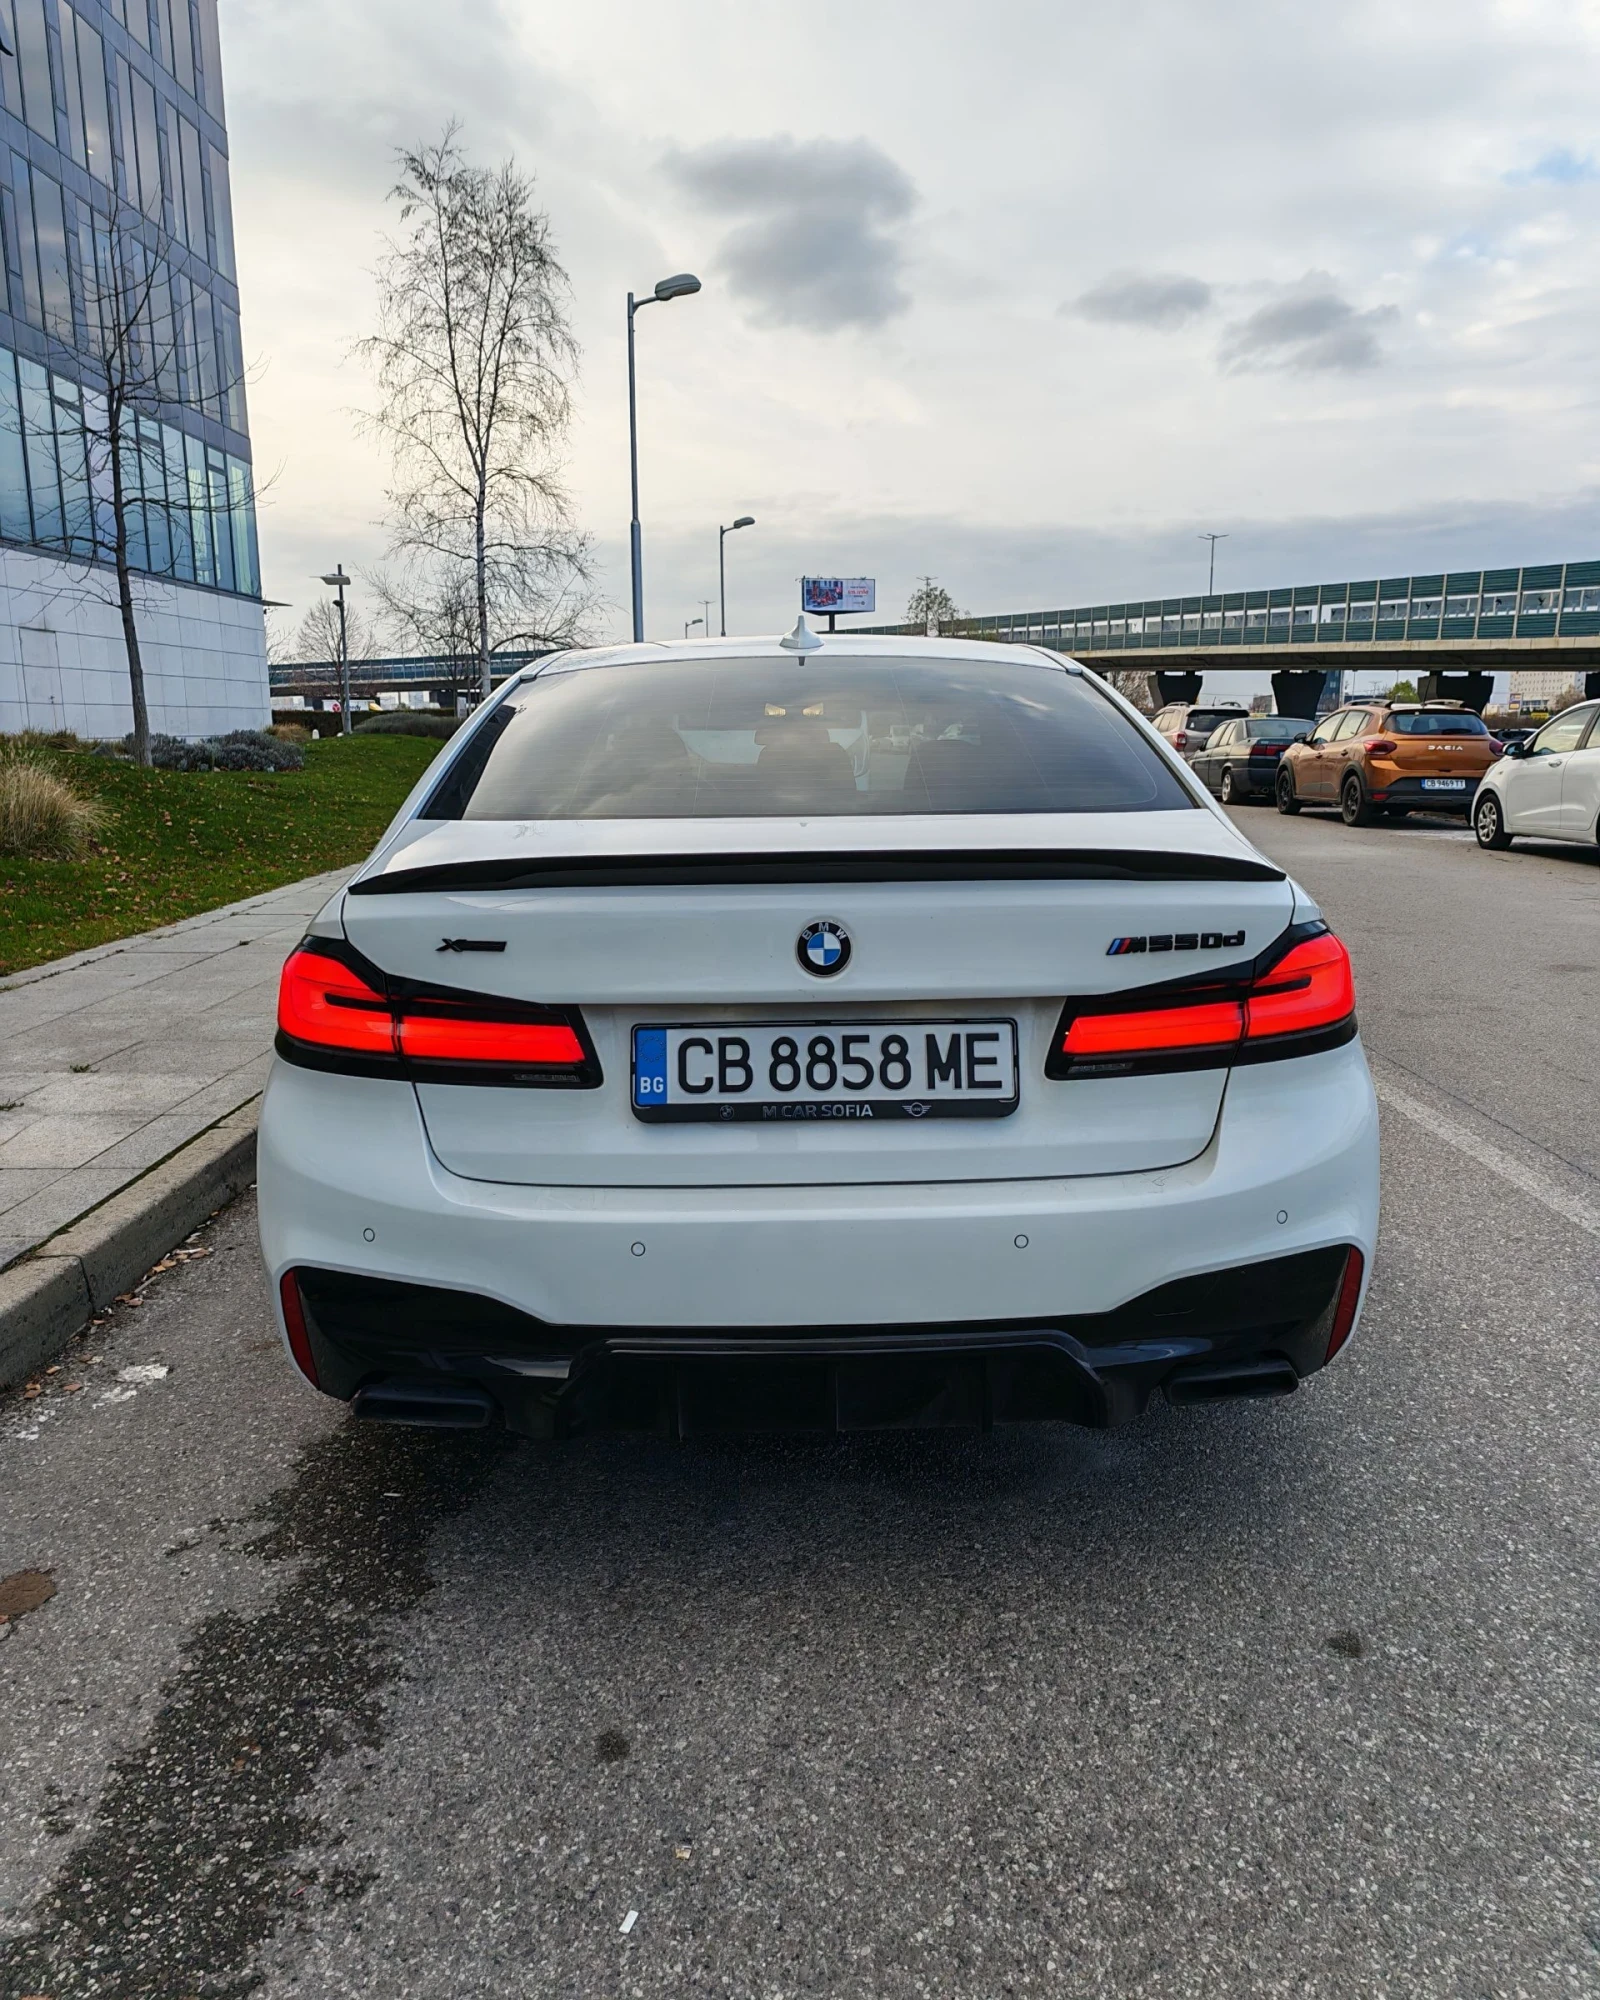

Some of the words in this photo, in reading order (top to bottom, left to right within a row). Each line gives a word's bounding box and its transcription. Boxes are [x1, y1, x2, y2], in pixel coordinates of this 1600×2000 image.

[801, 922, 847, 941] BMW
[1126, 930, 1246, 955] M550d
[677, 1037, 754, 1094] CB
[769, 1033, 912, 1092] 8858
[925, 1032, 1003, 1090] ME
[640, 1076, 664, 1094] BG
[762, 1105, 777, 1118] M
[781, 1104, 817, 1118] CAR
[821, 1103, 874, 1117] SOFIA
